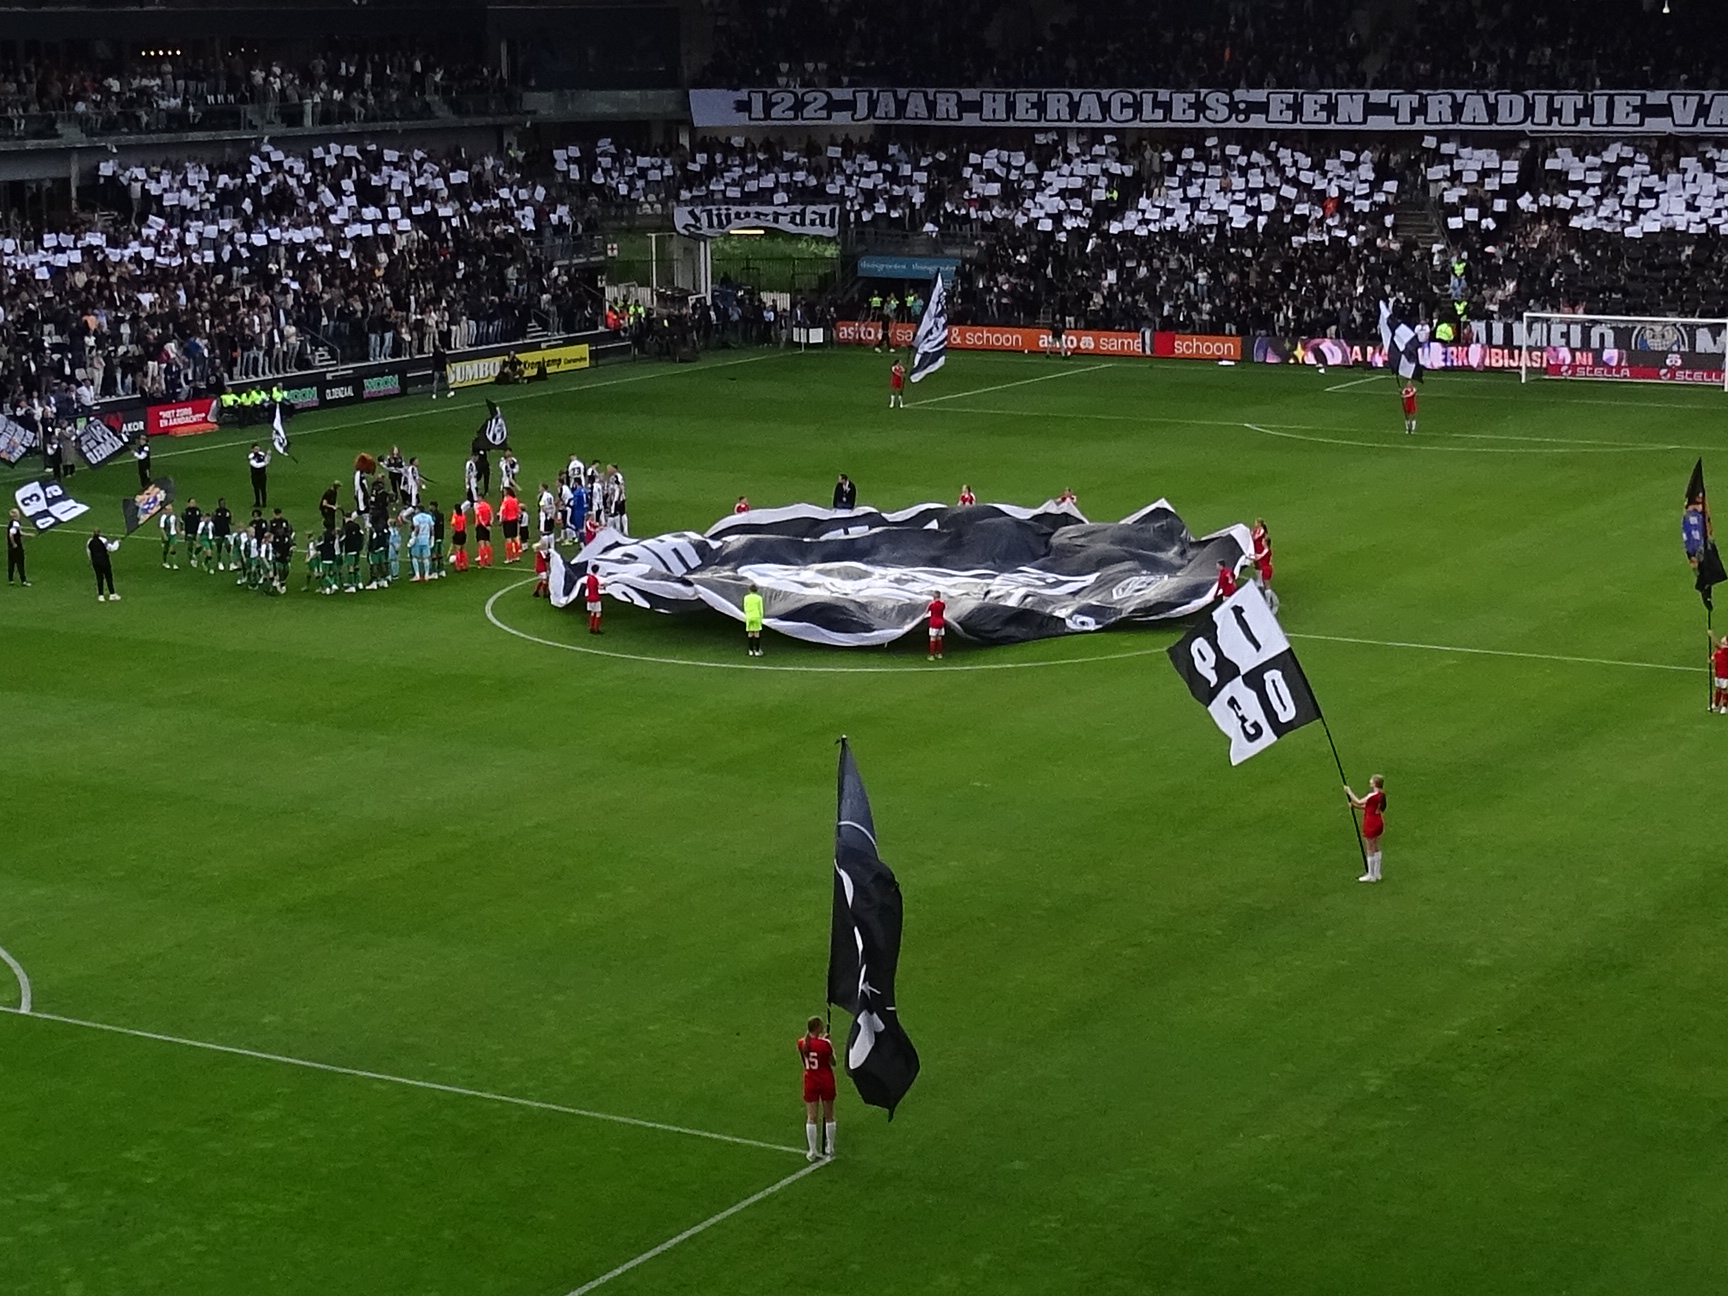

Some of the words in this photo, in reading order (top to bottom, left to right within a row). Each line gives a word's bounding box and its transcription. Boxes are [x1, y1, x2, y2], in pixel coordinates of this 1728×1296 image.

[748, 89, 832, 123] 122
[852, 89, 961, 123] JAAR
[983, 91, 1249, 124] HERACLES:
[1269, 92, 1373, 124] EEN
[1390, 92, 1645, 127] TRADITIE
[839, 323, 874, 340] asito
[950, 328, 962, 344] &
[966, 329, 1022, 347] schoon
[1099, 337, 1142, 352] same
[1174, 338, 1234, 355] schoon
